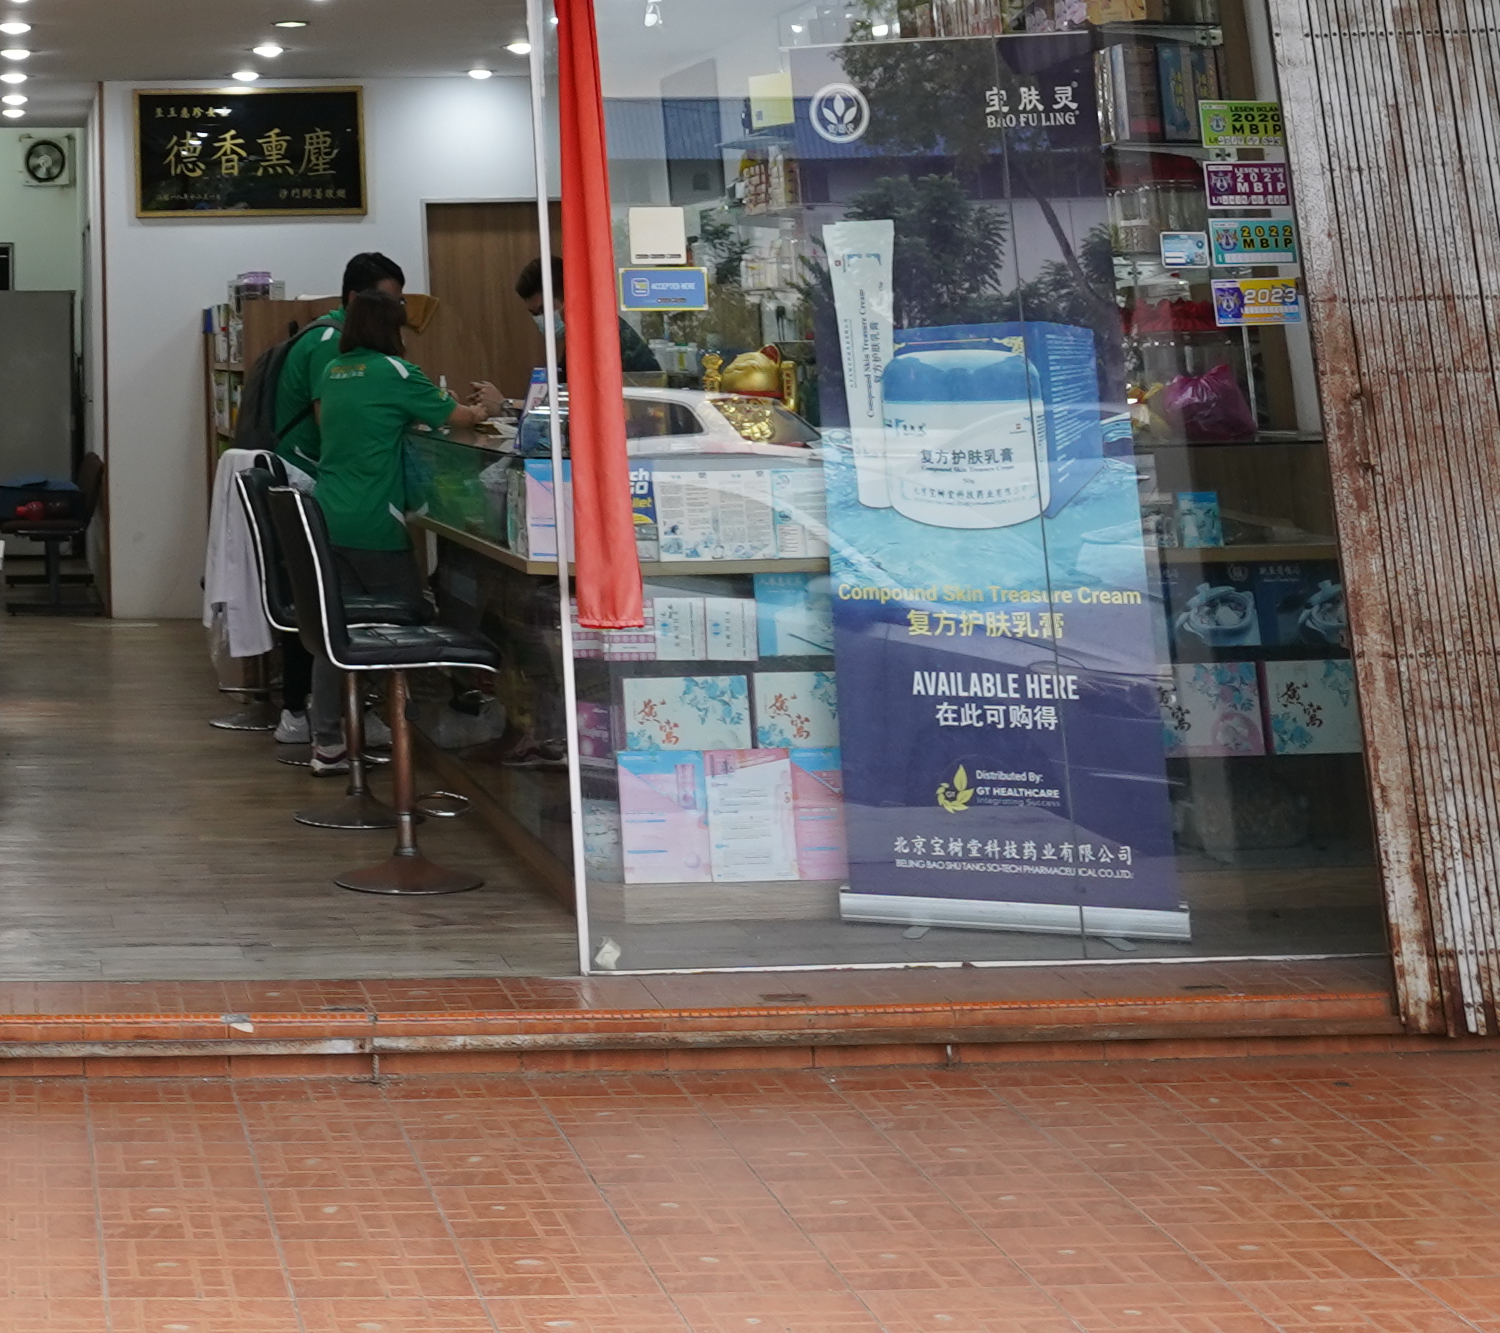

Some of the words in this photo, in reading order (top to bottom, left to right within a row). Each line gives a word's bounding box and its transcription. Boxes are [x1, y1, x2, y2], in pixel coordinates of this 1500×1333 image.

[985, 86, 1079, 113] 宝肤灵
[986, 114, 1017, 128] BAO
[1020, 113, 1038, 127] FU
[1041, 112, 1076, 126] LING
[1231, 113, 1280, 123] 2020
[1231, 123, 1282, 134] MBIP
[1236, 173, 1284, 182] 2021
[1236, 182, 1286, 193] MBIP
[1241, 225, 1293, 238] 2022
[1243, 238, 1293, 250] MBIP
[1243, 288, 1297, 304] 2023
[920, 447, 1015, 465] 复方护肤乳膏
[837, 583, 938, 604] Compound
[942, 584, 984, 602] Skin
[988, 585, 1073, 603] Treasure
[1076, 586, 1142, 605] Cream
[906, 609, 1065, 639] 复方护肤乳膏
[912, 670, 1021, 699] AVAILABLE
[1025, 674, 1081, 700] HERE
[935, 702, 1058, 731] 在此可购得
[976, 769, 1027, 782] Distributed
[1028, 771, 1044, 784] By:
[976, 786, 991, 796] GT
[992, 787, 1060, 799] HEALTHCARE
